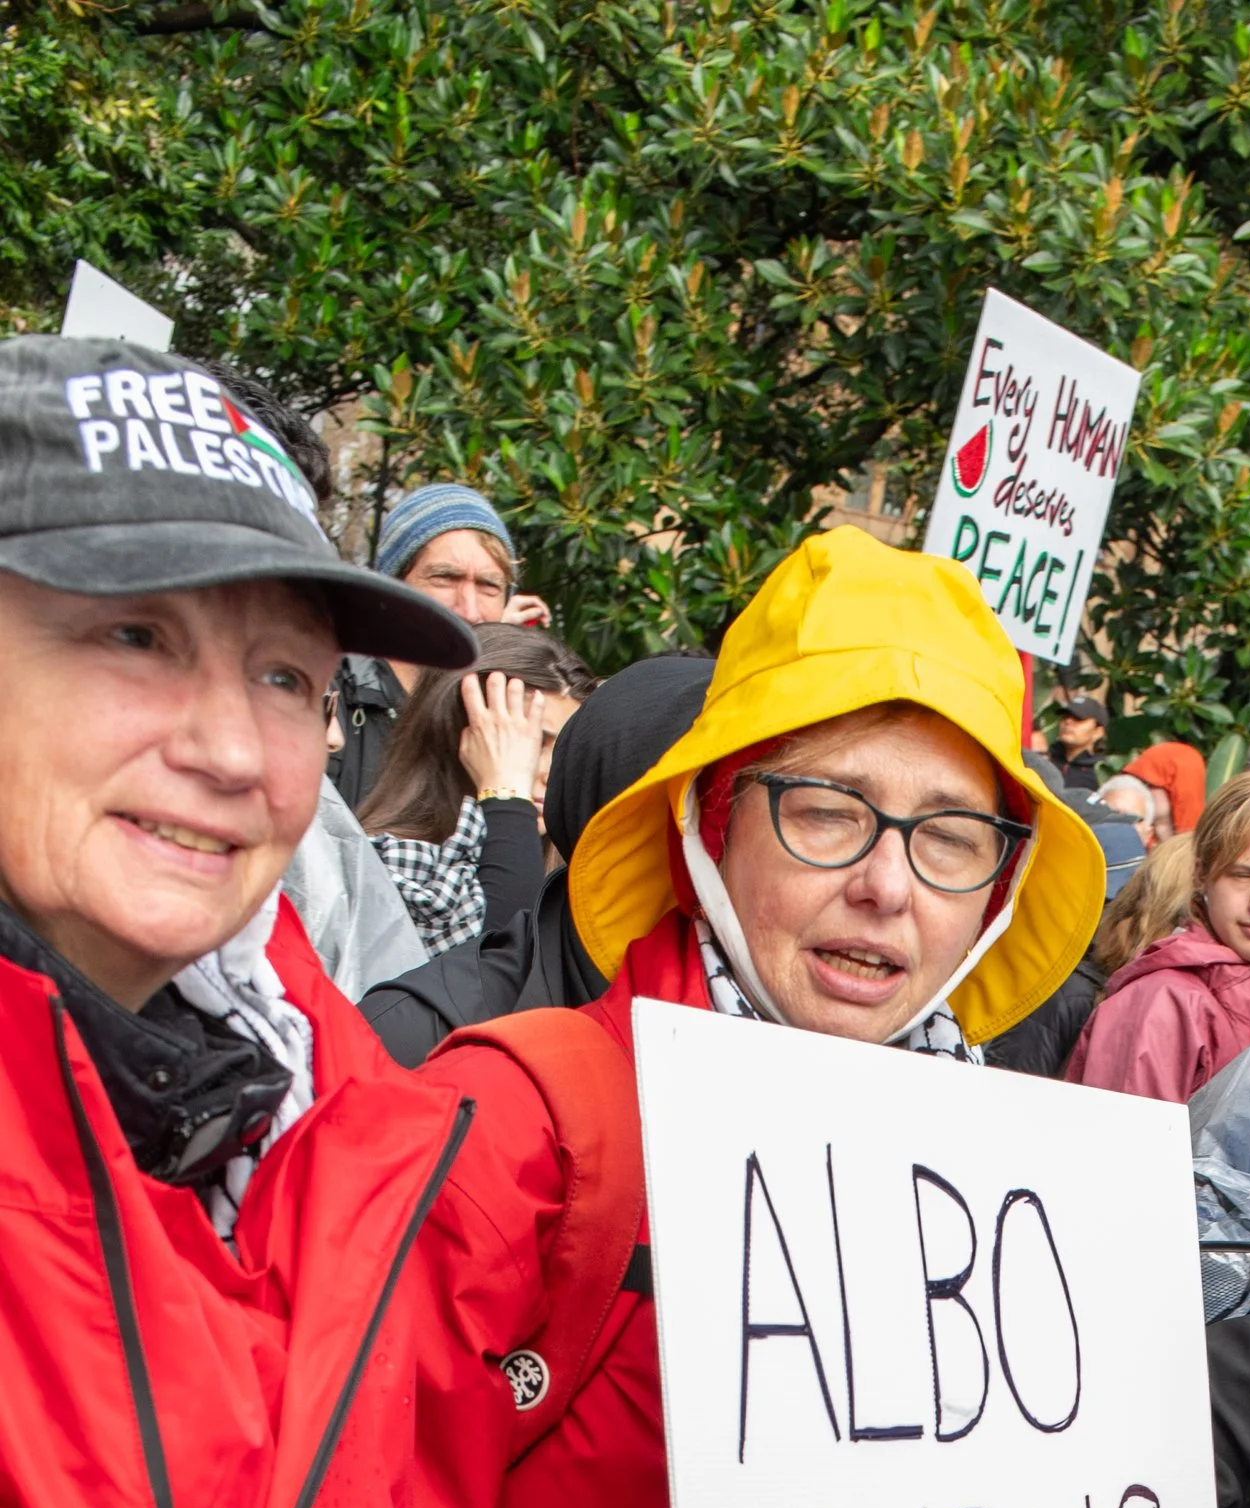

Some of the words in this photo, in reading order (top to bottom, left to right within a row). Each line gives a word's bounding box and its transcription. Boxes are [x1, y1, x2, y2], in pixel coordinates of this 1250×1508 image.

[66, 369, 233, 434] FREE
[973, 336, 1039, 463] Every
[1047, 374, 1128, 480] HUMAN
[992, 453, 1076, 537] deserves
[951, 514, 1085, 657] PEACE!
[738, 1142, 1082, 1465] ALBO
